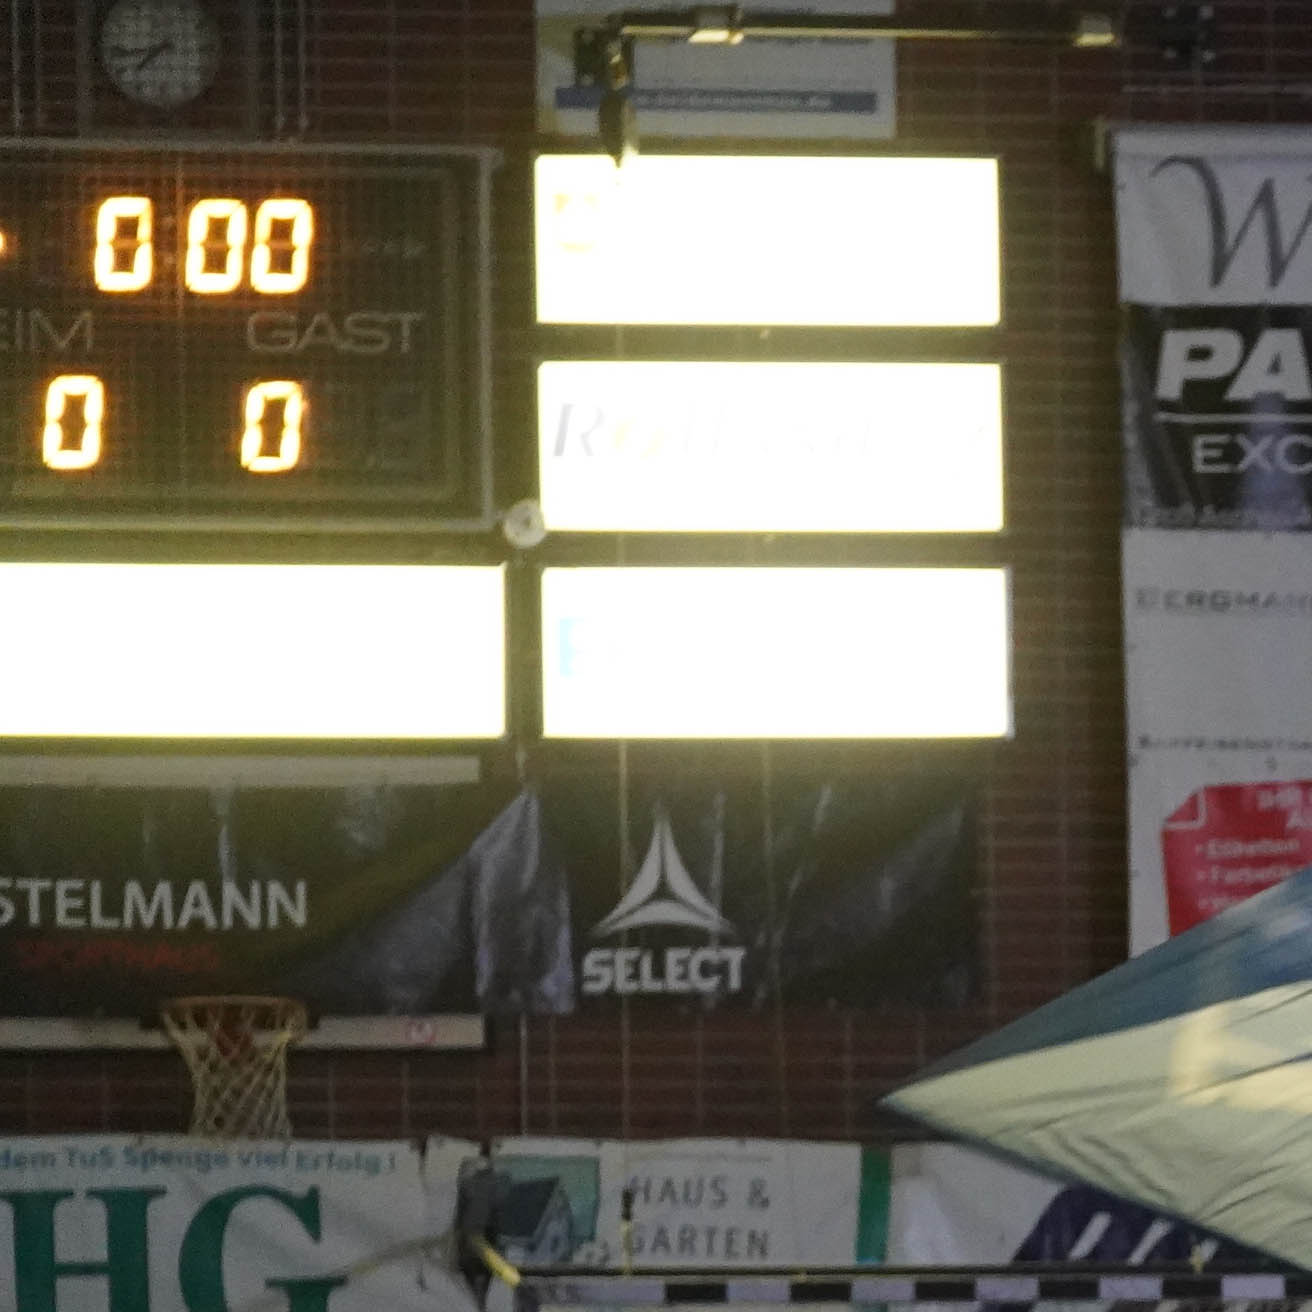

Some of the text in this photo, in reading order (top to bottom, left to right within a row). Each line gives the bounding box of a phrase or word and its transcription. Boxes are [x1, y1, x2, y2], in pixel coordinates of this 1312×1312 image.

[0, 308, 97, 352] IM
[246, 310, 426, 354] GAST
[43, 374, 105, 470] 0
[240, 380, 304, 473] 0
[582, 945, 748, 995] SELECT
